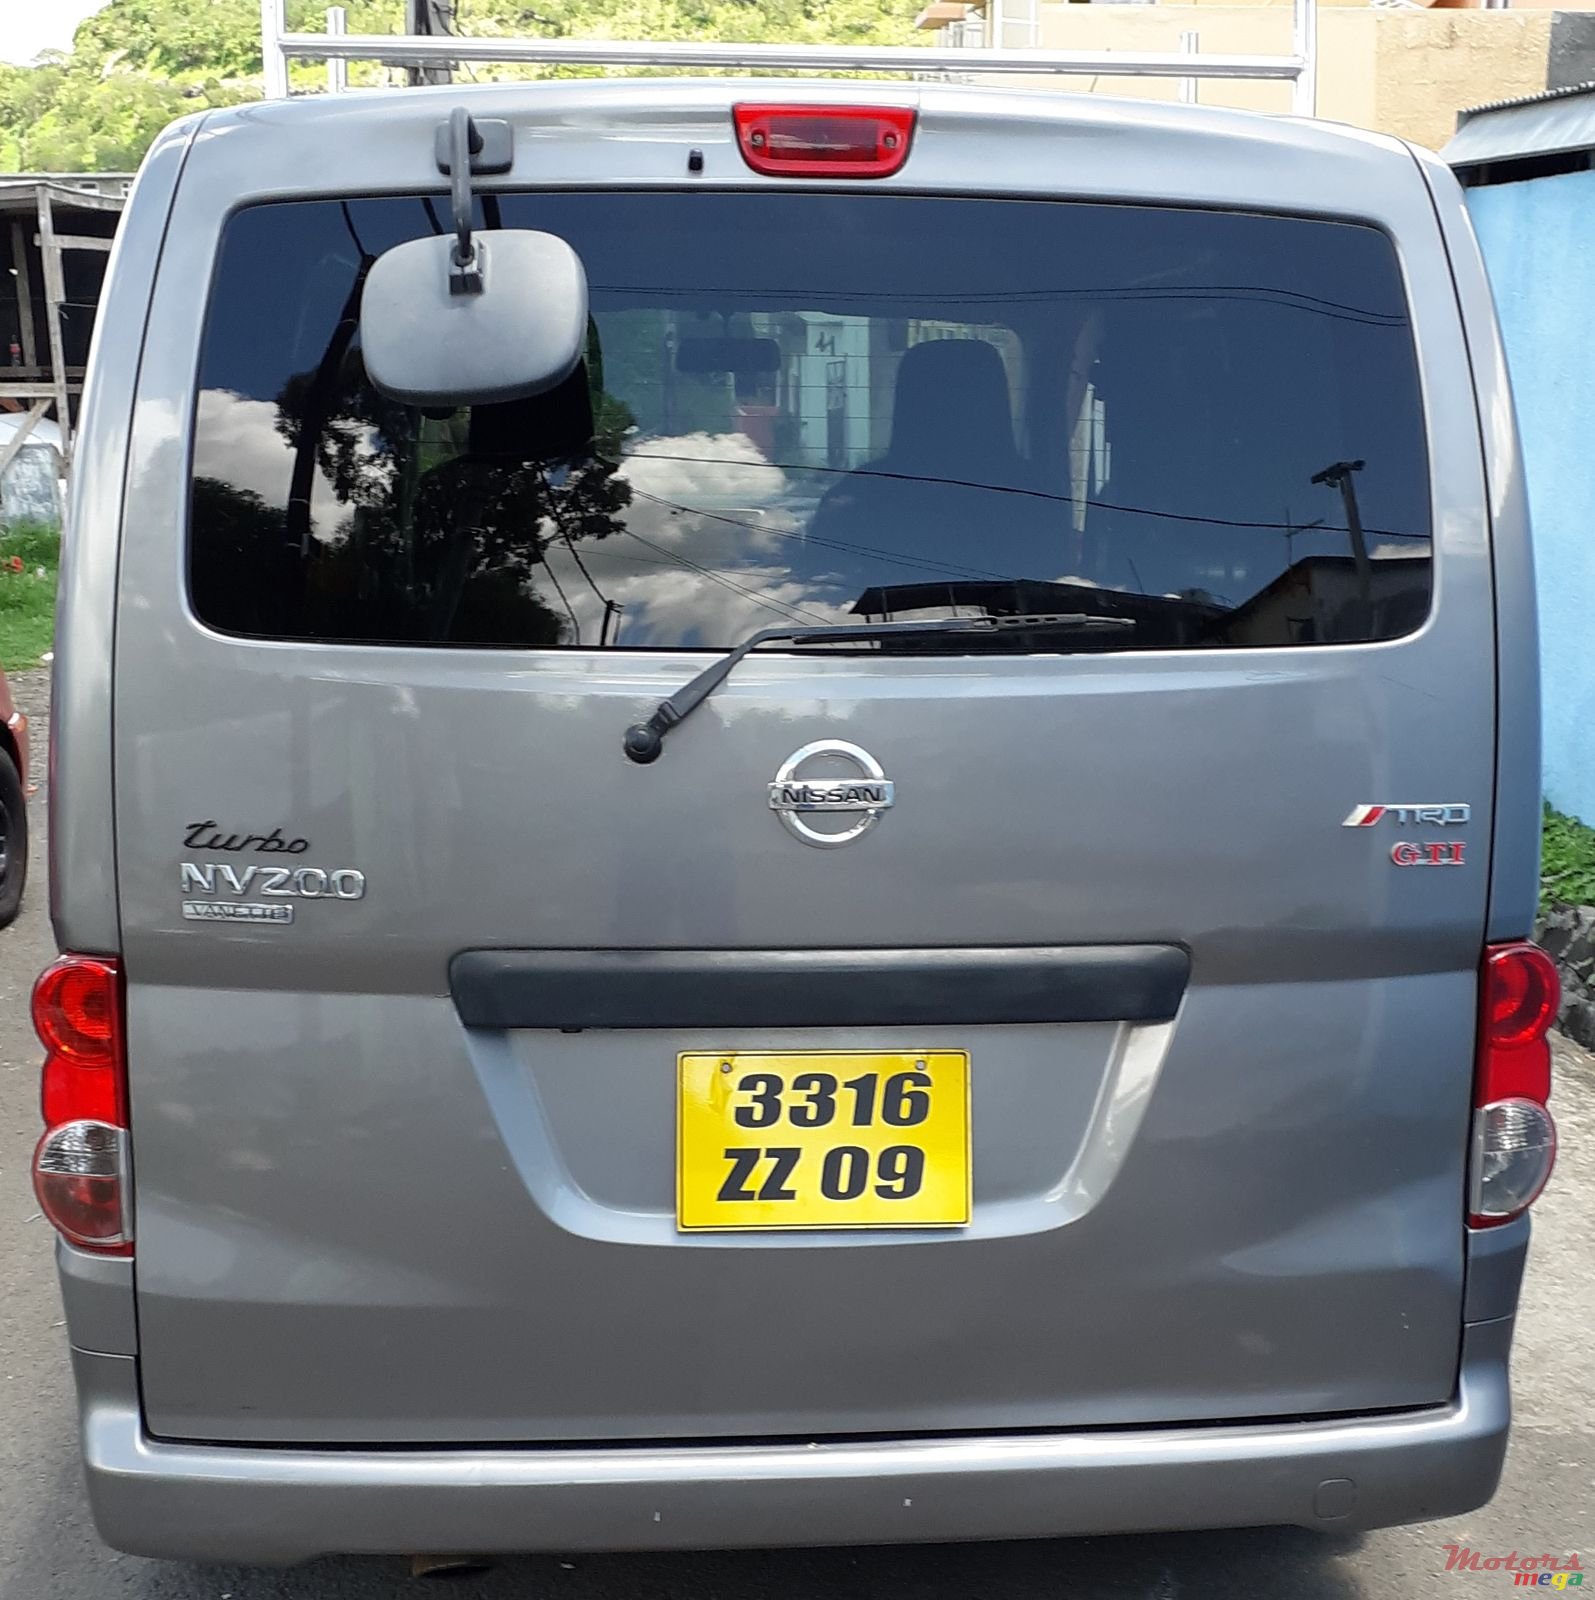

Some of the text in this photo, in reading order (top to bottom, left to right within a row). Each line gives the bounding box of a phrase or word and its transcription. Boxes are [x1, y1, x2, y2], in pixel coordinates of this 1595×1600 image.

[781, 787, 882, 804] NISSAN
[1386, 803, 1472, 826] TRD
[183, 820, 309, 853] turbo
[1391, 841, 1467, 866] GTI
[180, 862, 367, 900] NV200
[734, 1072, 933, 1129] 3316
[716, 1145, 926, 1202] ZZ 09
